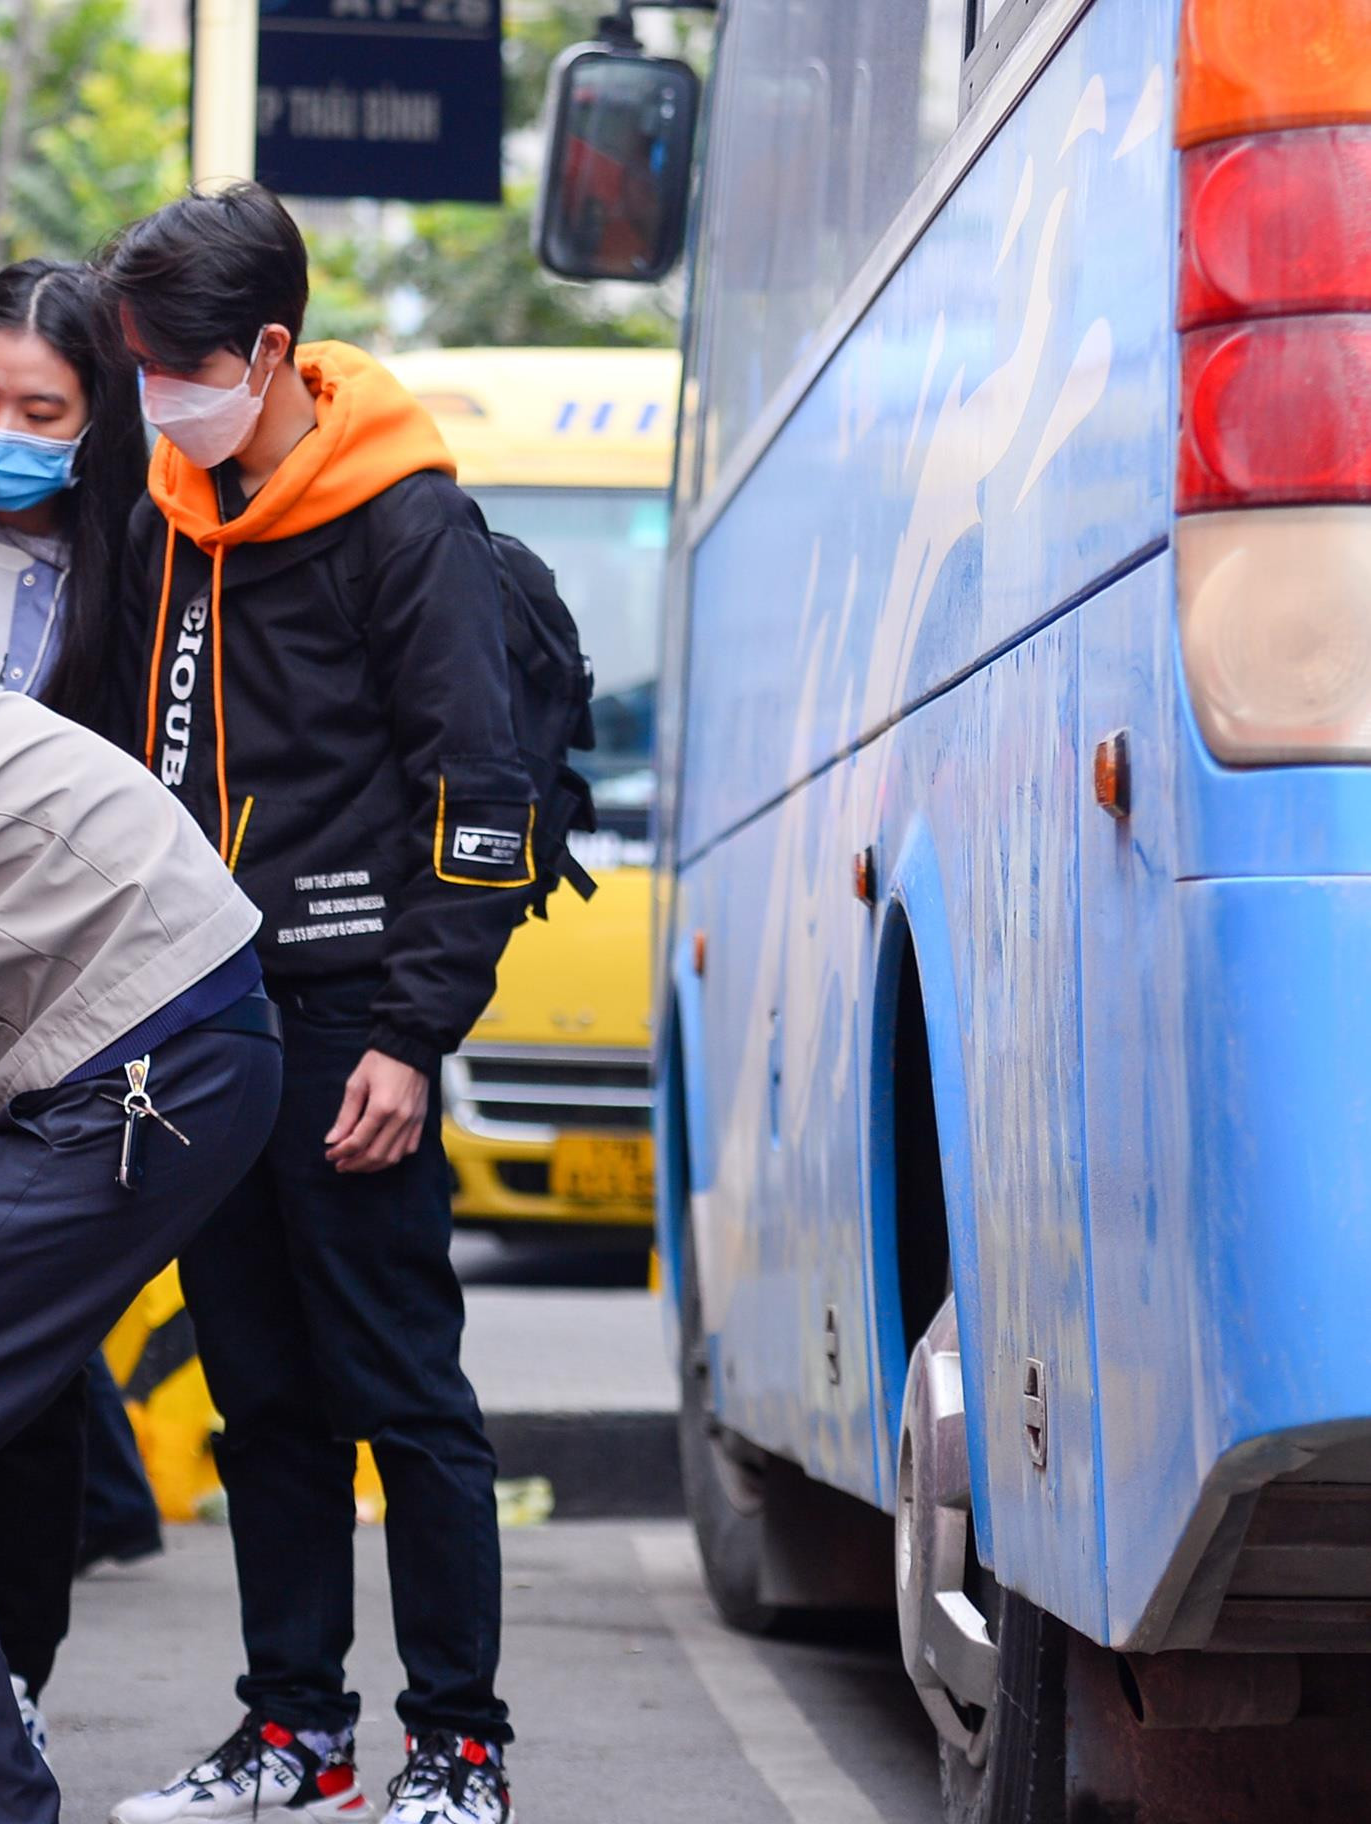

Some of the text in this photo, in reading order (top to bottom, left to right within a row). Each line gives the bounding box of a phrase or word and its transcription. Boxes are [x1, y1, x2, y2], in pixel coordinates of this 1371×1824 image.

[313, 875, 327, 889] THE
[327, 873, 346, 888] LIGHT
[346, 917, 384, 934] CHRISTMAS
